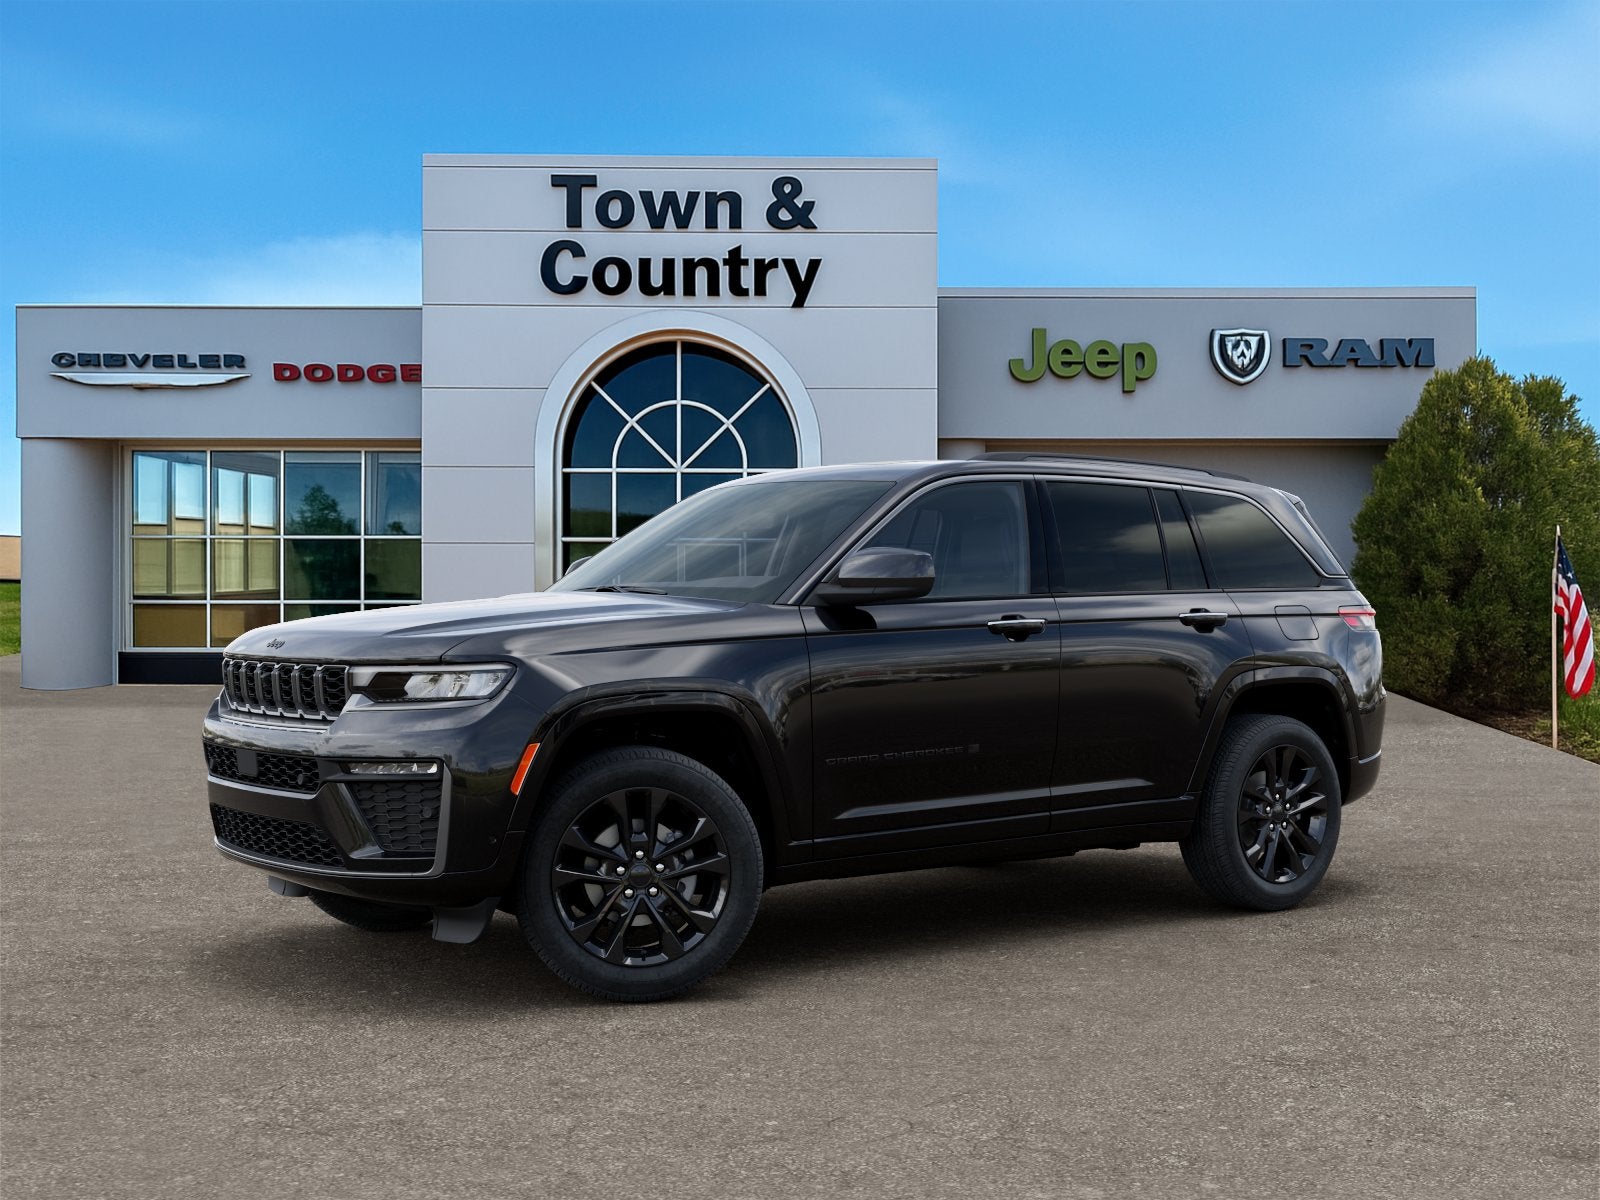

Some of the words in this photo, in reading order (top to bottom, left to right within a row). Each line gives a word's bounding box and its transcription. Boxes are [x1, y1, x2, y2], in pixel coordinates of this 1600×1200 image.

[550, 174, 742, 229] Town
[766, 175, 818, 230] &
[540, 239, 822, 308] Country
[273, 363, 422, 383] DODGE
[1009, 328, 1157, 393] Jeep
[1283, 338, 1435, 367] RAM
